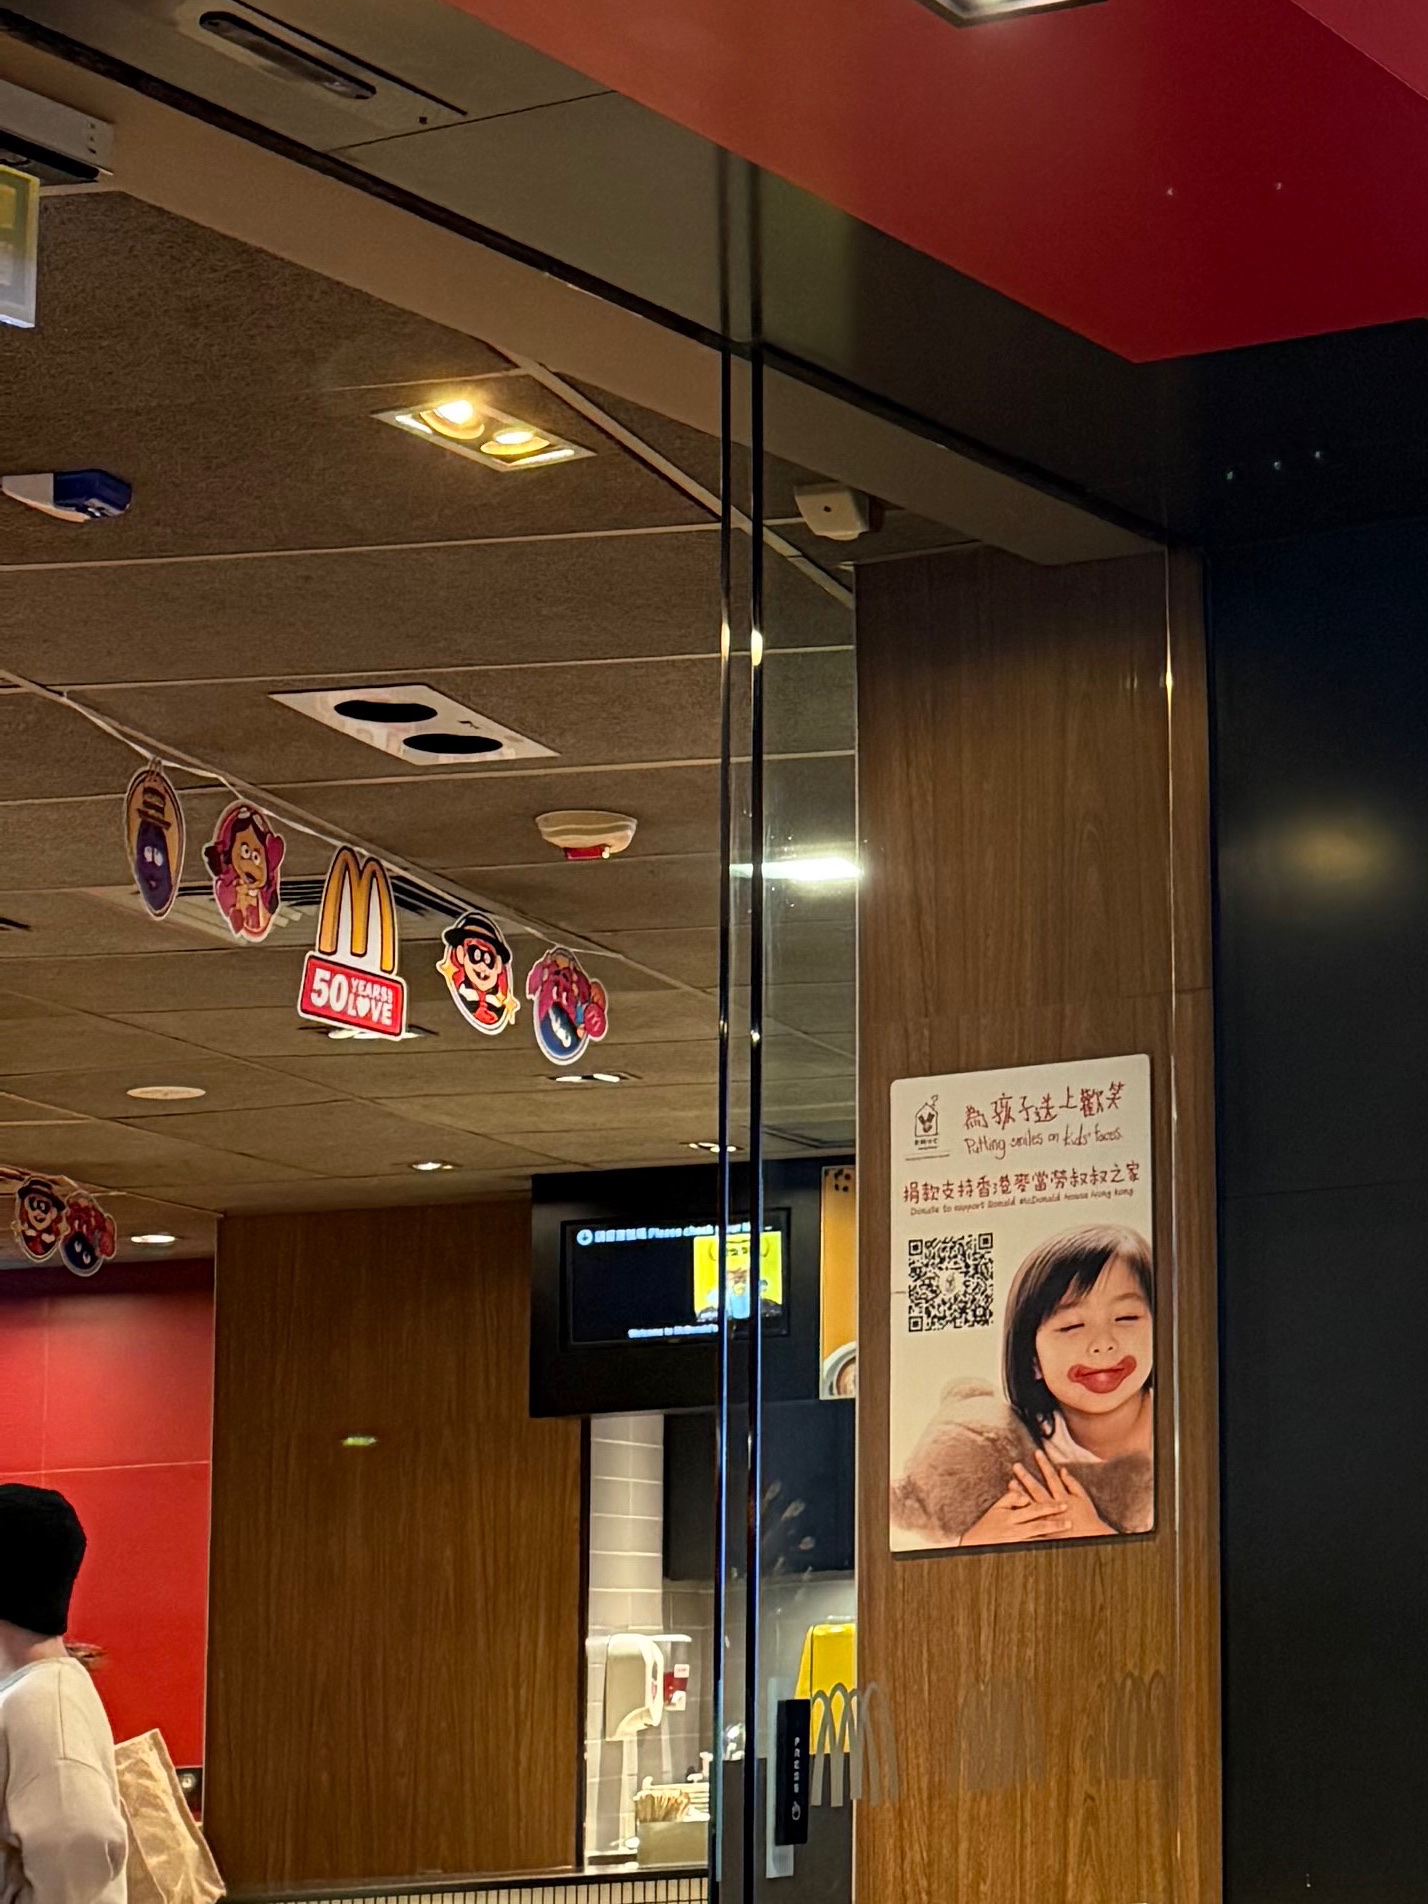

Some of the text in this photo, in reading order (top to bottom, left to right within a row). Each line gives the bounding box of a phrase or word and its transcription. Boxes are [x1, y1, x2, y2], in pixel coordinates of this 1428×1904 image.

[310, 967, 349, 1012] 50
[965, 1081, 1125, 1131] 為孩子送上歡笑
[964, 1135, 1006, 1160] Putting
[1011, 1128, 1043, 1147] smiles
[1048, 1132, 1060, 1143] on
[903, 1161, 1140, 1204] 捐款支持香港麥當勞叔叔之家
